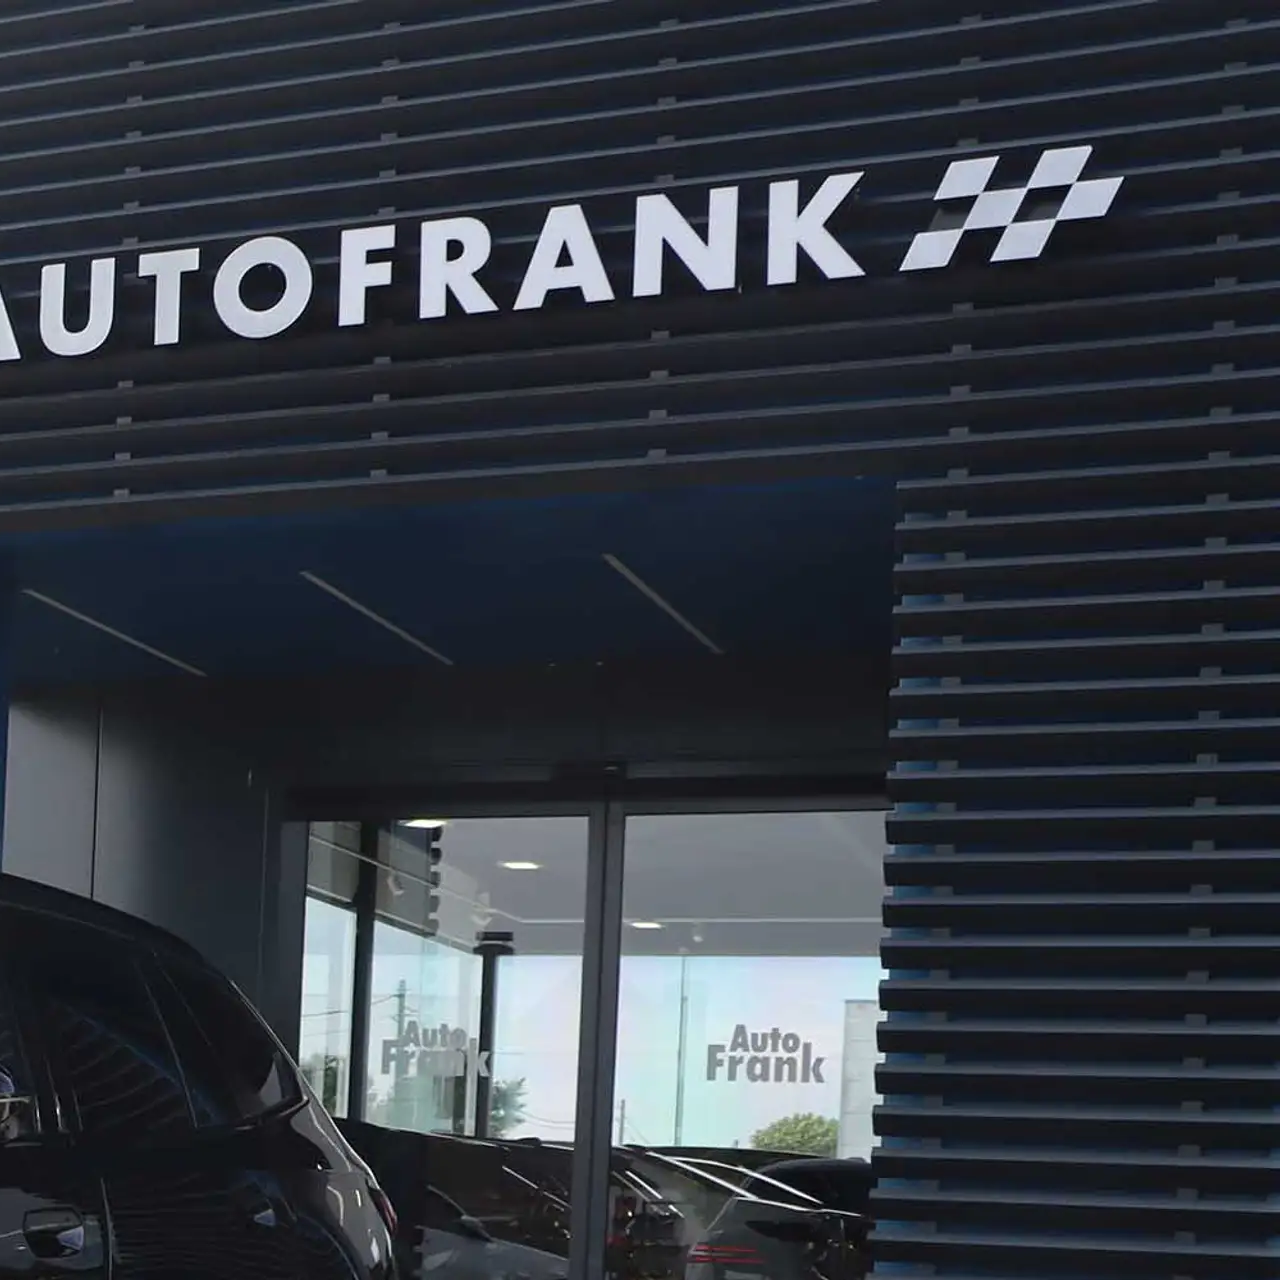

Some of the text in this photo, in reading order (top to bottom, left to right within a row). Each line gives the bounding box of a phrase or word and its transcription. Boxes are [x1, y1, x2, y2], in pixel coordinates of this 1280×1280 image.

[403, 1020, 467, 1049] Auto
[729, 1024, 800, 1053] Auto
[381, 1038, 491, 1076] Frank
[706, 1042, 826, 1083] Frank
